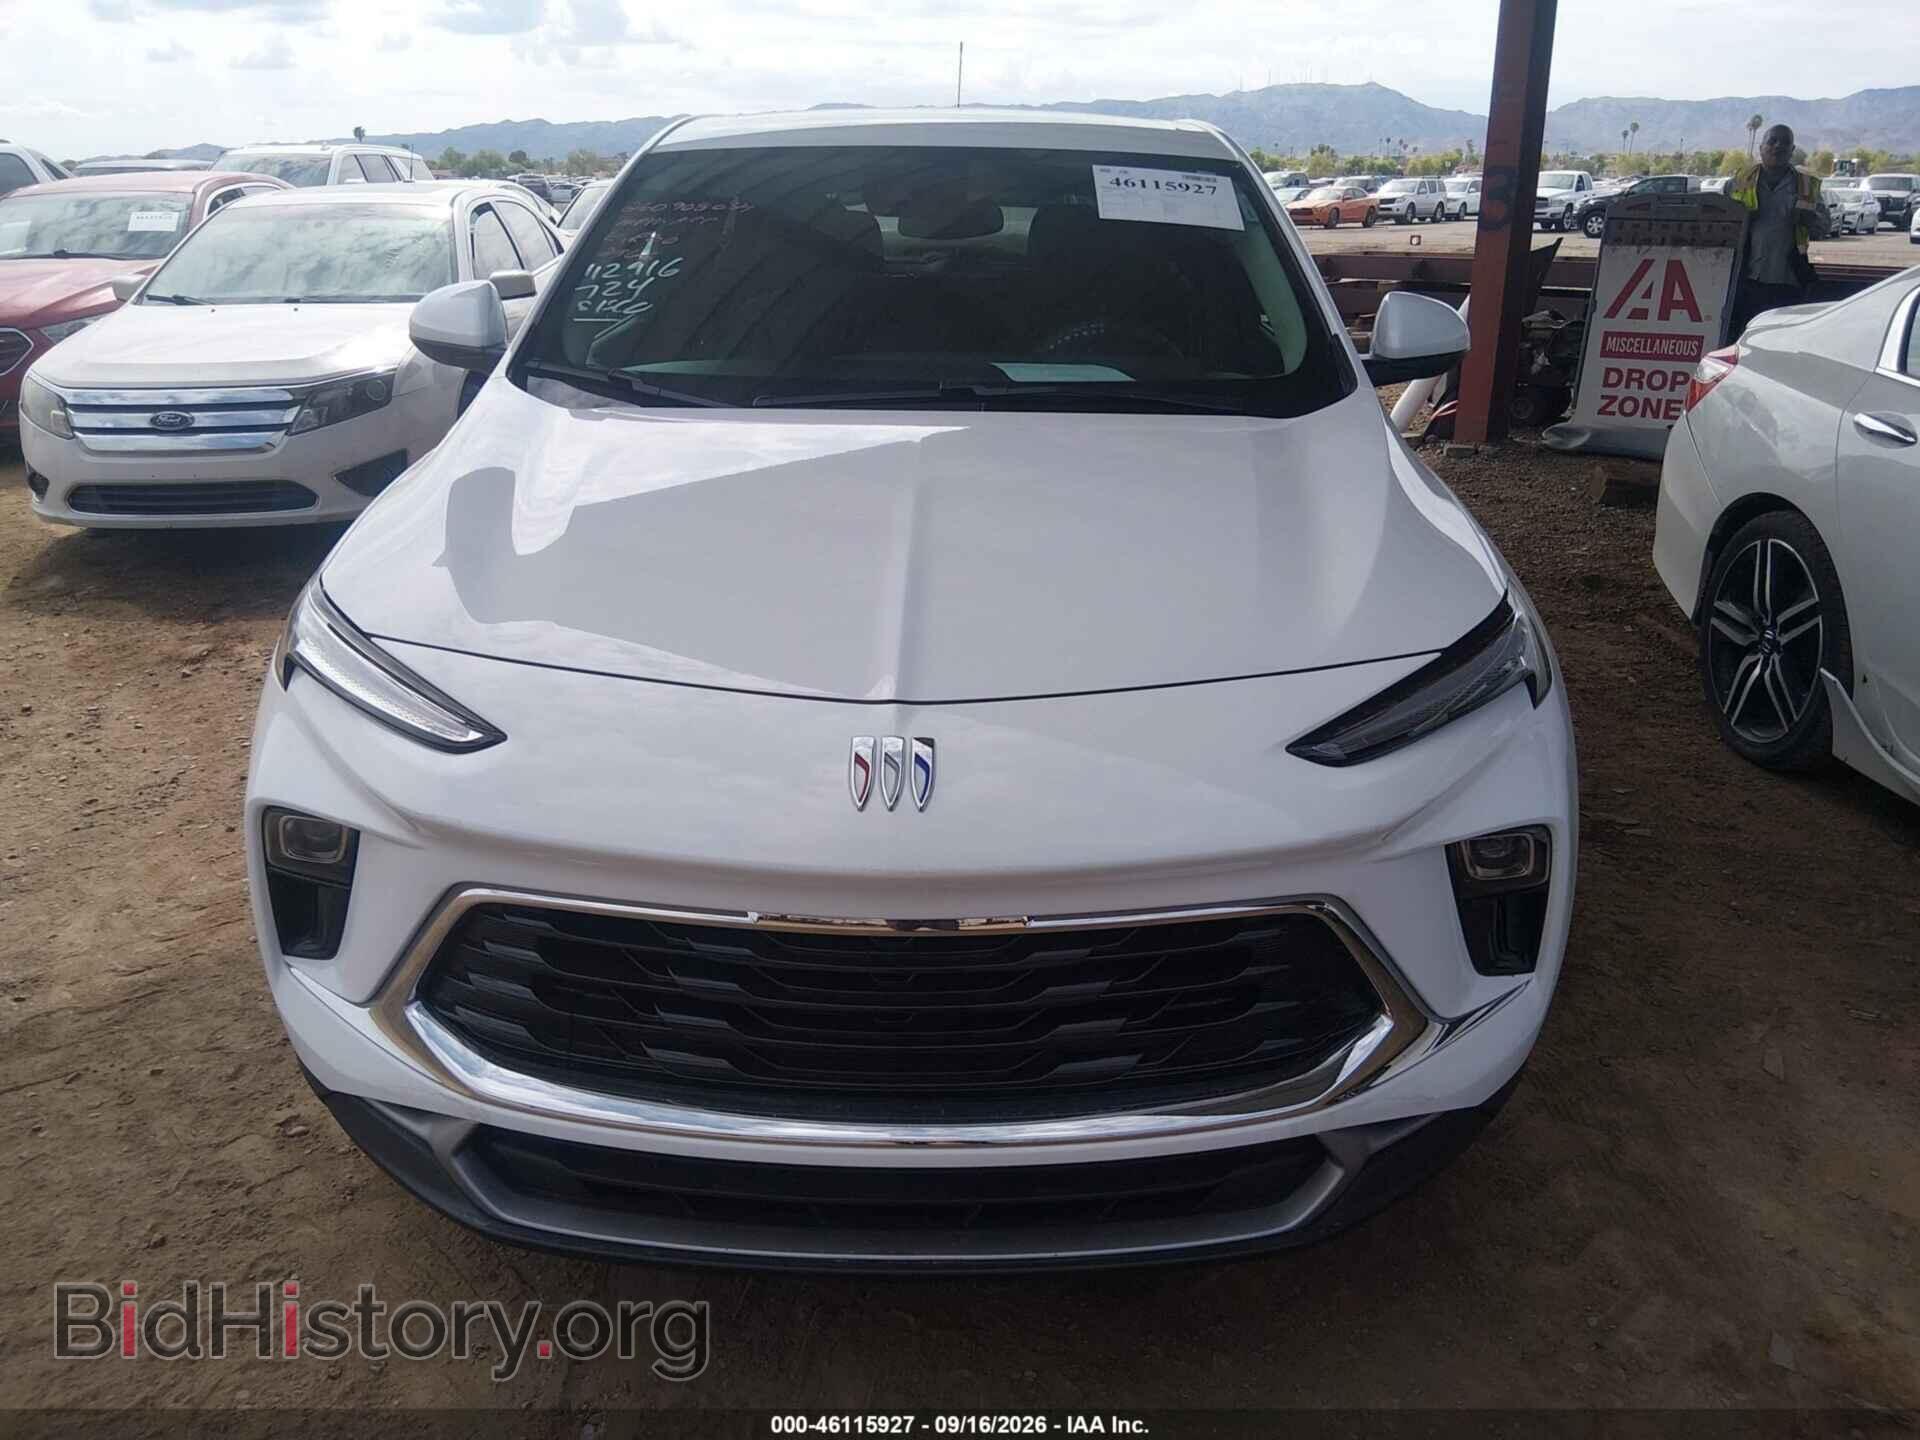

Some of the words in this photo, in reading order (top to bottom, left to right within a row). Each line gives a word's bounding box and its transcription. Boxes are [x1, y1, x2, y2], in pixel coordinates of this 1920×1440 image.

[1110, 177, 1217, 196] 46115927
[1606, 336, 1699, 356] MISCELLANEOUS
[1602, 367, 1690, 392] DROP
[1597, 394, 1685, 420] ZONE
